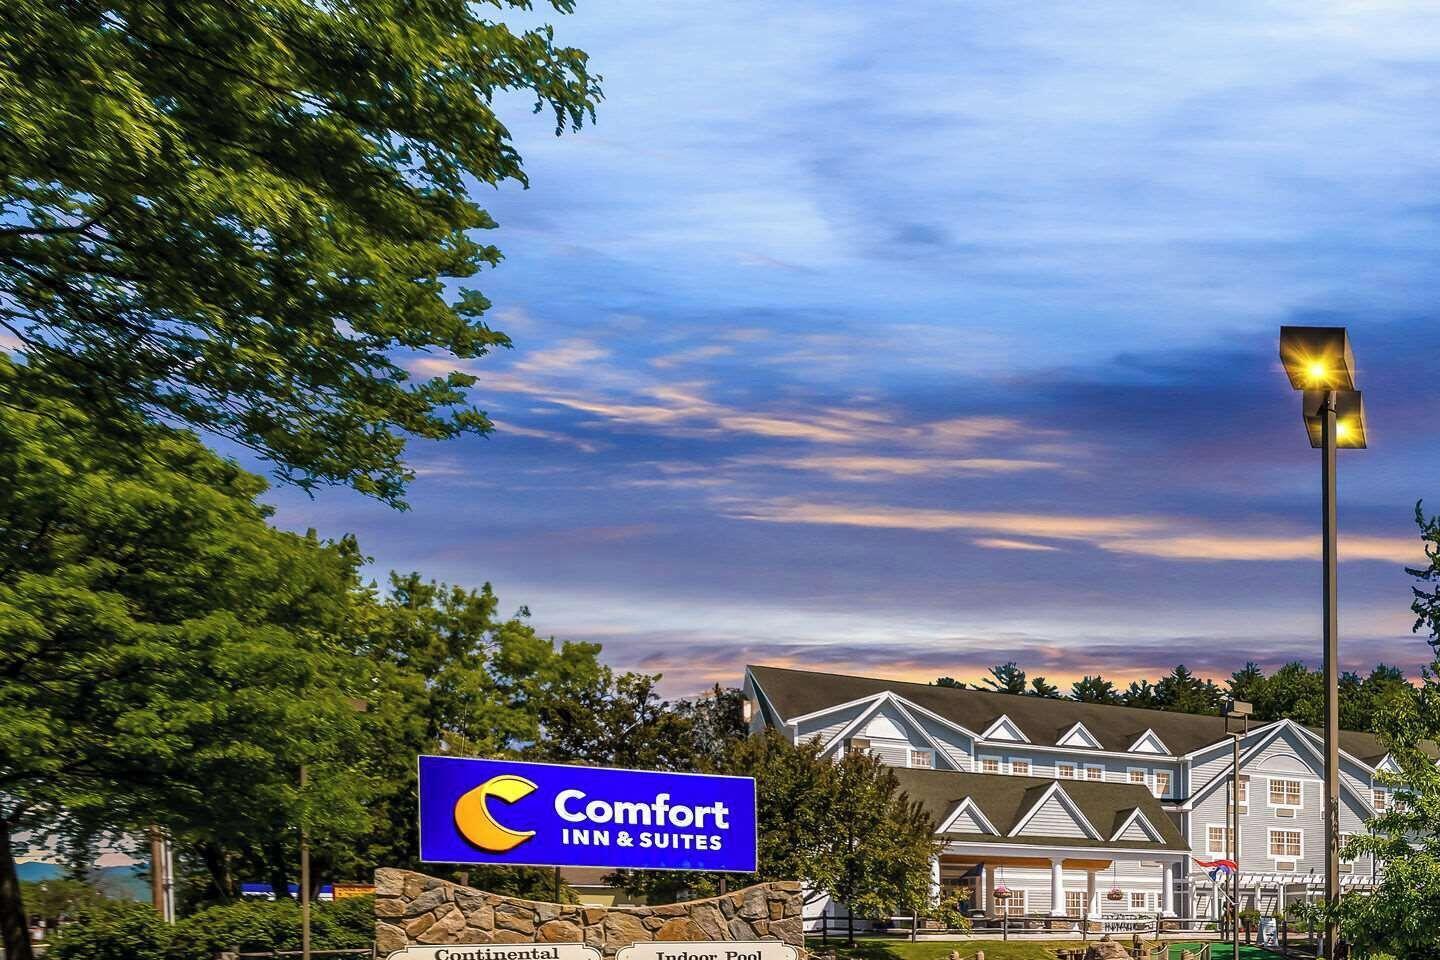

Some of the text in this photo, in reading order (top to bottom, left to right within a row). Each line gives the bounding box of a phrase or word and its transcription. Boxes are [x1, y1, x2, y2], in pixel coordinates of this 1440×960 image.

[554, 789, 730, 829] Comfort
[562, 828, 722, 850] INN & SUITES
